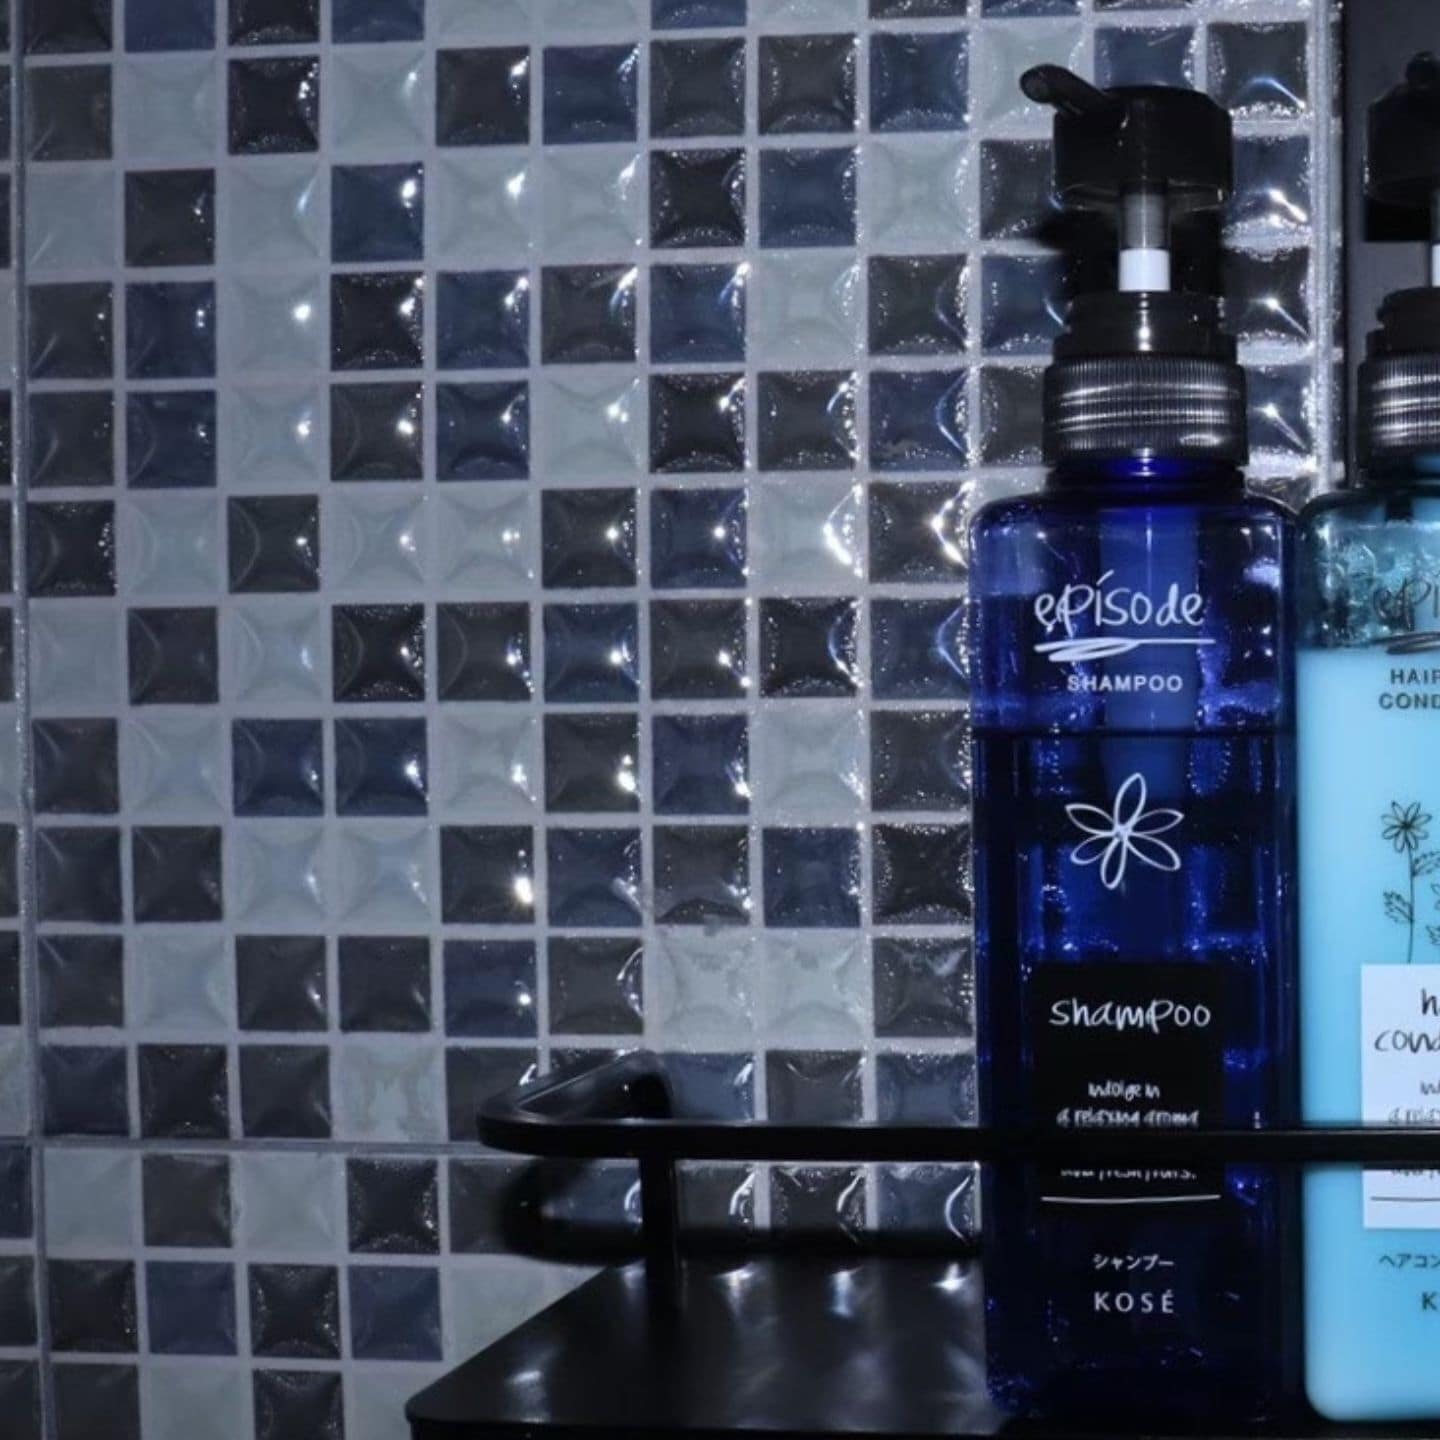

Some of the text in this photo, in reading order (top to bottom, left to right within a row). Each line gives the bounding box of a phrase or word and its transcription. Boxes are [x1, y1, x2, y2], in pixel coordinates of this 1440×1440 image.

[1034, 570, 1203, 638] episode
[1067, 675, 1183, 692] SHAMPOO
[1092, 1253, 1175, 1271] シャンプー
[1094, 1290, 1175, 1314] KOSÉ
